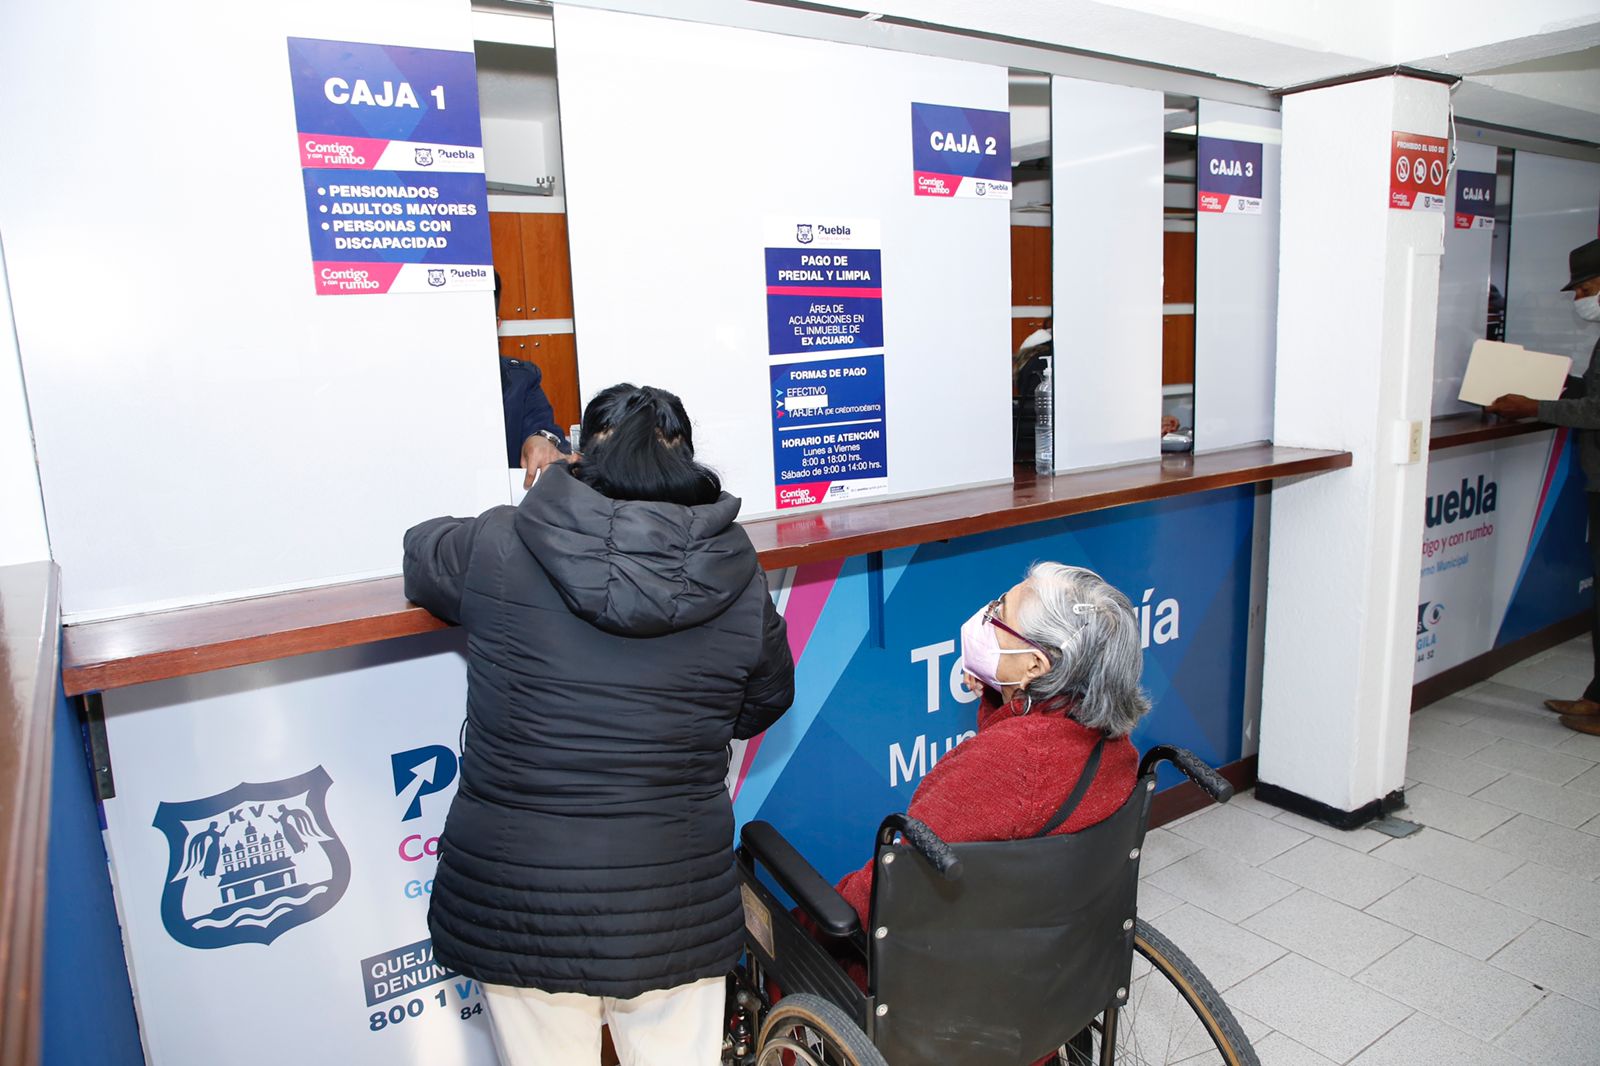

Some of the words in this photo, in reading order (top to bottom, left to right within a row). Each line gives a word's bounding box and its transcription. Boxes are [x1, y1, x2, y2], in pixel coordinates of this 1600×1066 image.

[324, 77, 419, 109] CAJA
[430, 86, 446, 110] 1
[305, 140, 354, 157] Contigo
[930, 131, 980, 154] CAJA
[985, 136, 997, 155] 2
[325, 154, 365, 165] rumbo
[438, 149, 475, 159] Puebla
[1210, 158, 1242, 176] CAJA
[1245, 162, 1253, 177] 3
[330, 185, 439, 198] PENSIONADOS
[1463, 187, 1483, 201] CAJA
[1484, 190, 1490, 202] 4
[332, 203, 403, 215] ADULTOS
[406, 204, 477, 216] MAYORES
[334, 220, 416, 232] PERSONAS
[420, 220, 452, 232] CON
[818, 225, 851, 235] Puebla
[336, 237, 447, 250] DISCAPACIDAD
[802, 256, 830, 266] PAGO
[834, 256, 848, 266] DE
[321, 268, 368, 281] Contigo
[450, 268, 487, 278] Puebla
[778, 270, 824, 281] PREDIAL
[826, 270, 834, 280] Y
[836, 270, 871, 280] LIMPIA
[340, 280, 380, 289] rumbo
[810, 303, 832, 314] ÁREA
[833, 304, 844, 313] DE
[788, 315, 852, 325] ACLARACIONES
[854, 314, 864, 323] EN
[794, 327, 804, 336] EL
[806, 325, 848, 335] INMUEBLE
[850, 324, 860, 334] DE
[802, 337, 814, 346] EX
[816, 335, 854, 345] ACUARIO
[790, 370, 827, 380] FORMAS
[830, 369, 840, 378] DE
[844, 368, 867, 376] PAGO
[787, 386, 826, 397] EFECTIVO
[788, 407, 824, 418] TARJETA
[782, 436, 821, 448] HORARIO
[824, 435, 835, 444] DE
[838, 430, 880, 444] ATENCIÓN
[804, 447, 826, 456] Lunes
[834, 444, 860, 453] Viernes
[802, 457, 818, 466] 8:00
[828, 455, 847, 464] 18:00
[849, 453, 862, 462] hrs.
[782, 468, 811, 480] Sábado
[813, 466, 822, 476] de
[824, 465, 840, 474] 9:00
[848, 462, 868, 471] 14:00
[868, 460, 882, 469] hrs.
[780, 488, 810, 499] Contigo
[1448, 532, 1464, 546] con
[1466, 522, 1494, 542] rumbo
[374, 964, 455, 998] DENUN
[370, 998, 424, 1032] 800
[434, 989, 446, 1008] 1
[460, 1002, 483, 1020] 84
